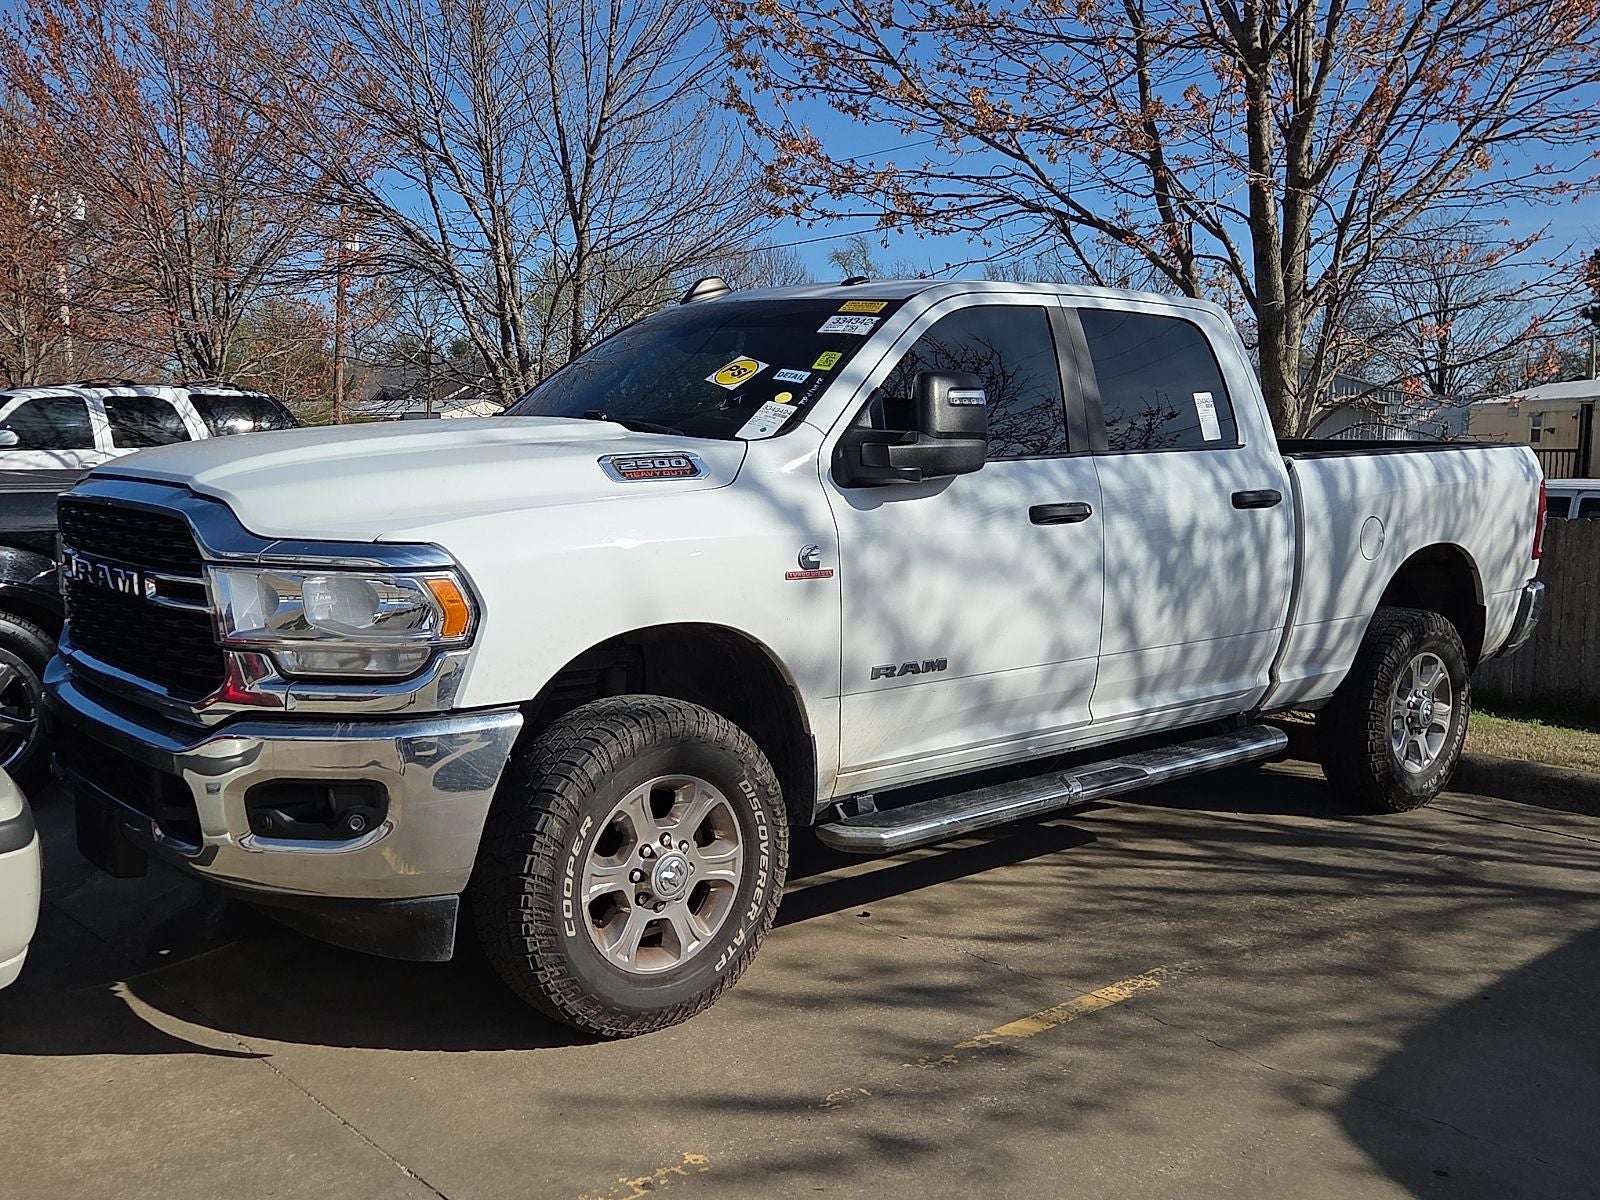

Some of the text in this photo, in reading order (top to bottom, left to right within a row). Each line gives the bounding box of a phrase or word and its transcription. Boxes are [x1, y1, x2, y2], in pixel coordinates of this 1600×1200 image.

[777, 372, 805, 381] DETAIL
[619, 459, 687, 471] 2500
[624, 470, 661, 478] HEAVY
[72, 555, 139, 596] RAM
[871, 658, 948, 680] RAM
[562, 815, 594, 937] COOPER
[714, 780, 769, 972] DISCOVERER ATP
